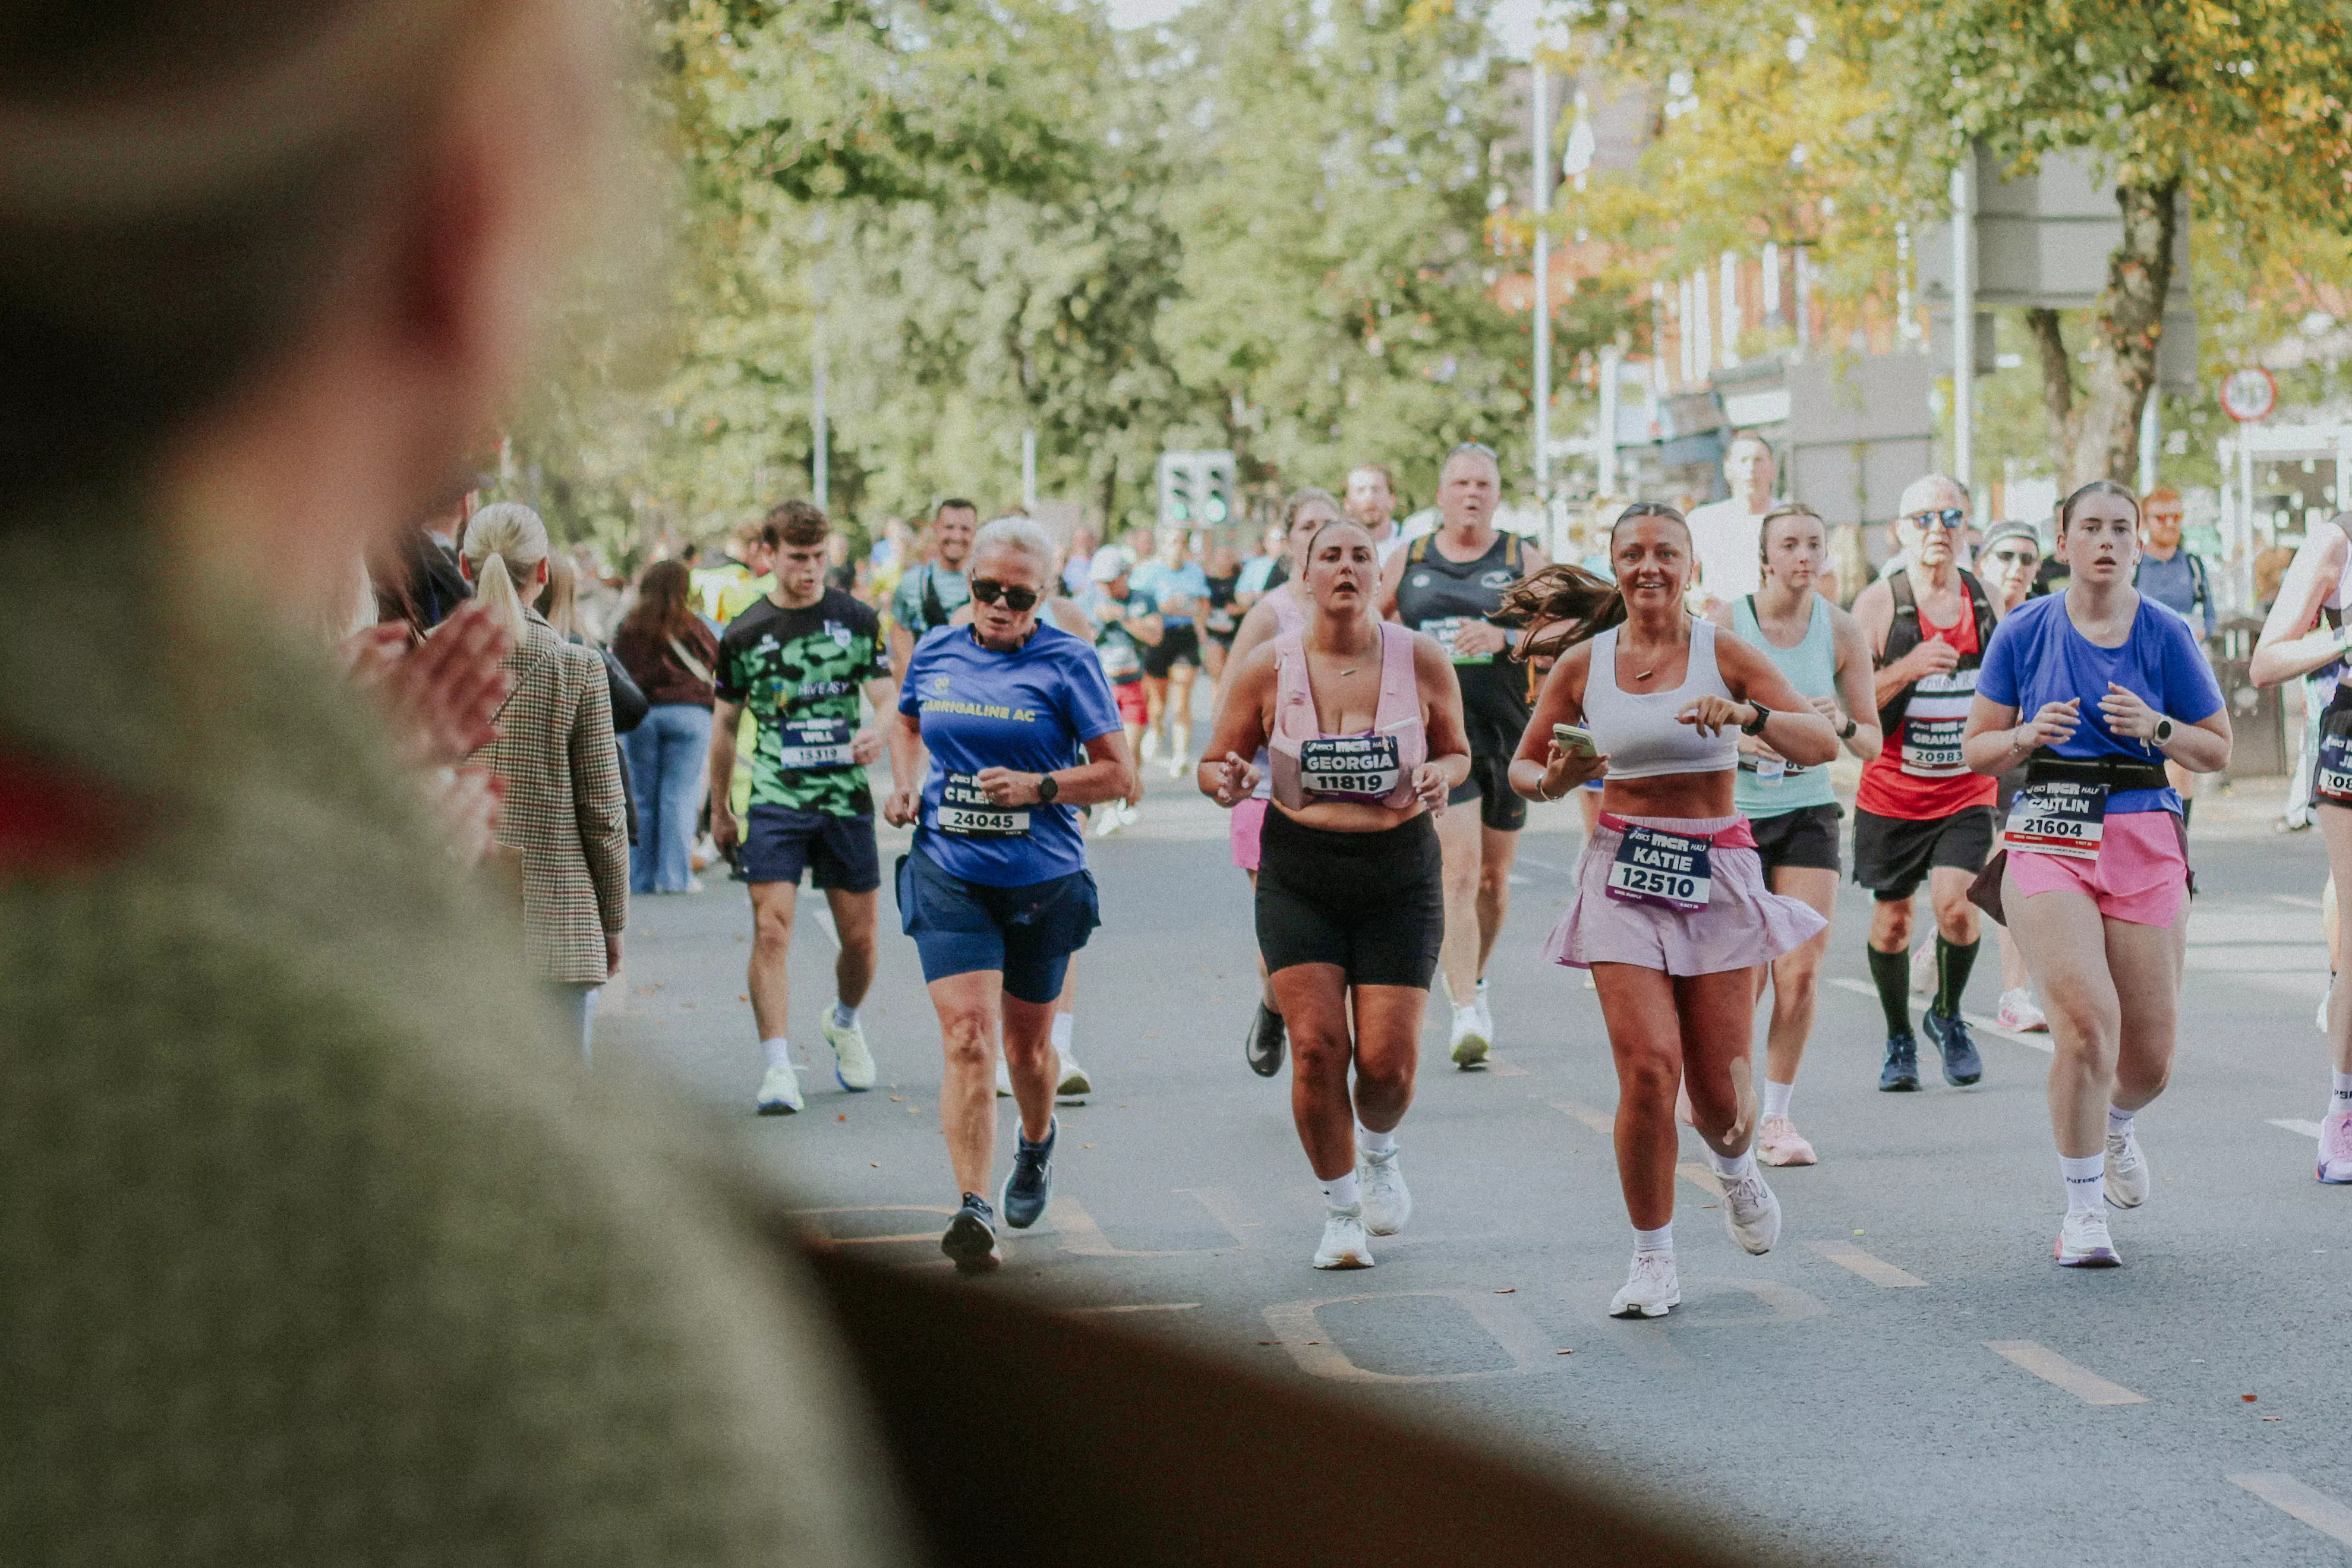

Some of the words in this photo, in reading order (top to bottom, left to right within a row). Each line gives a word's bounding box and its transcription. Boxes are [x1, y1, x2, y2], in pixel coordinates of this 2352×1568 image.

[1013, 709, 1036, 723] AC
[1335, 740, 1370, 752] MCR
[1307, 753, 1393, 770] GEORGIA
[1916, 750, 1963, 762] 20983
[1317, 775, 1382, 791] 11819
[2047, 783, 2080, 794] MCR
[944, 786, 956, 800] C
[2027, 797, 2089, 813] CAITLIN
[954, 812, 1013, 828] 24045
[2023, 819, 2082, 837] 21604
[1651, 834, 1689, 852] MCR
[1690, 843, 1707, 851] HALF
[1633, 846, 1693, 872] KATIE
[1623, 867, 1695, 897] 12510
